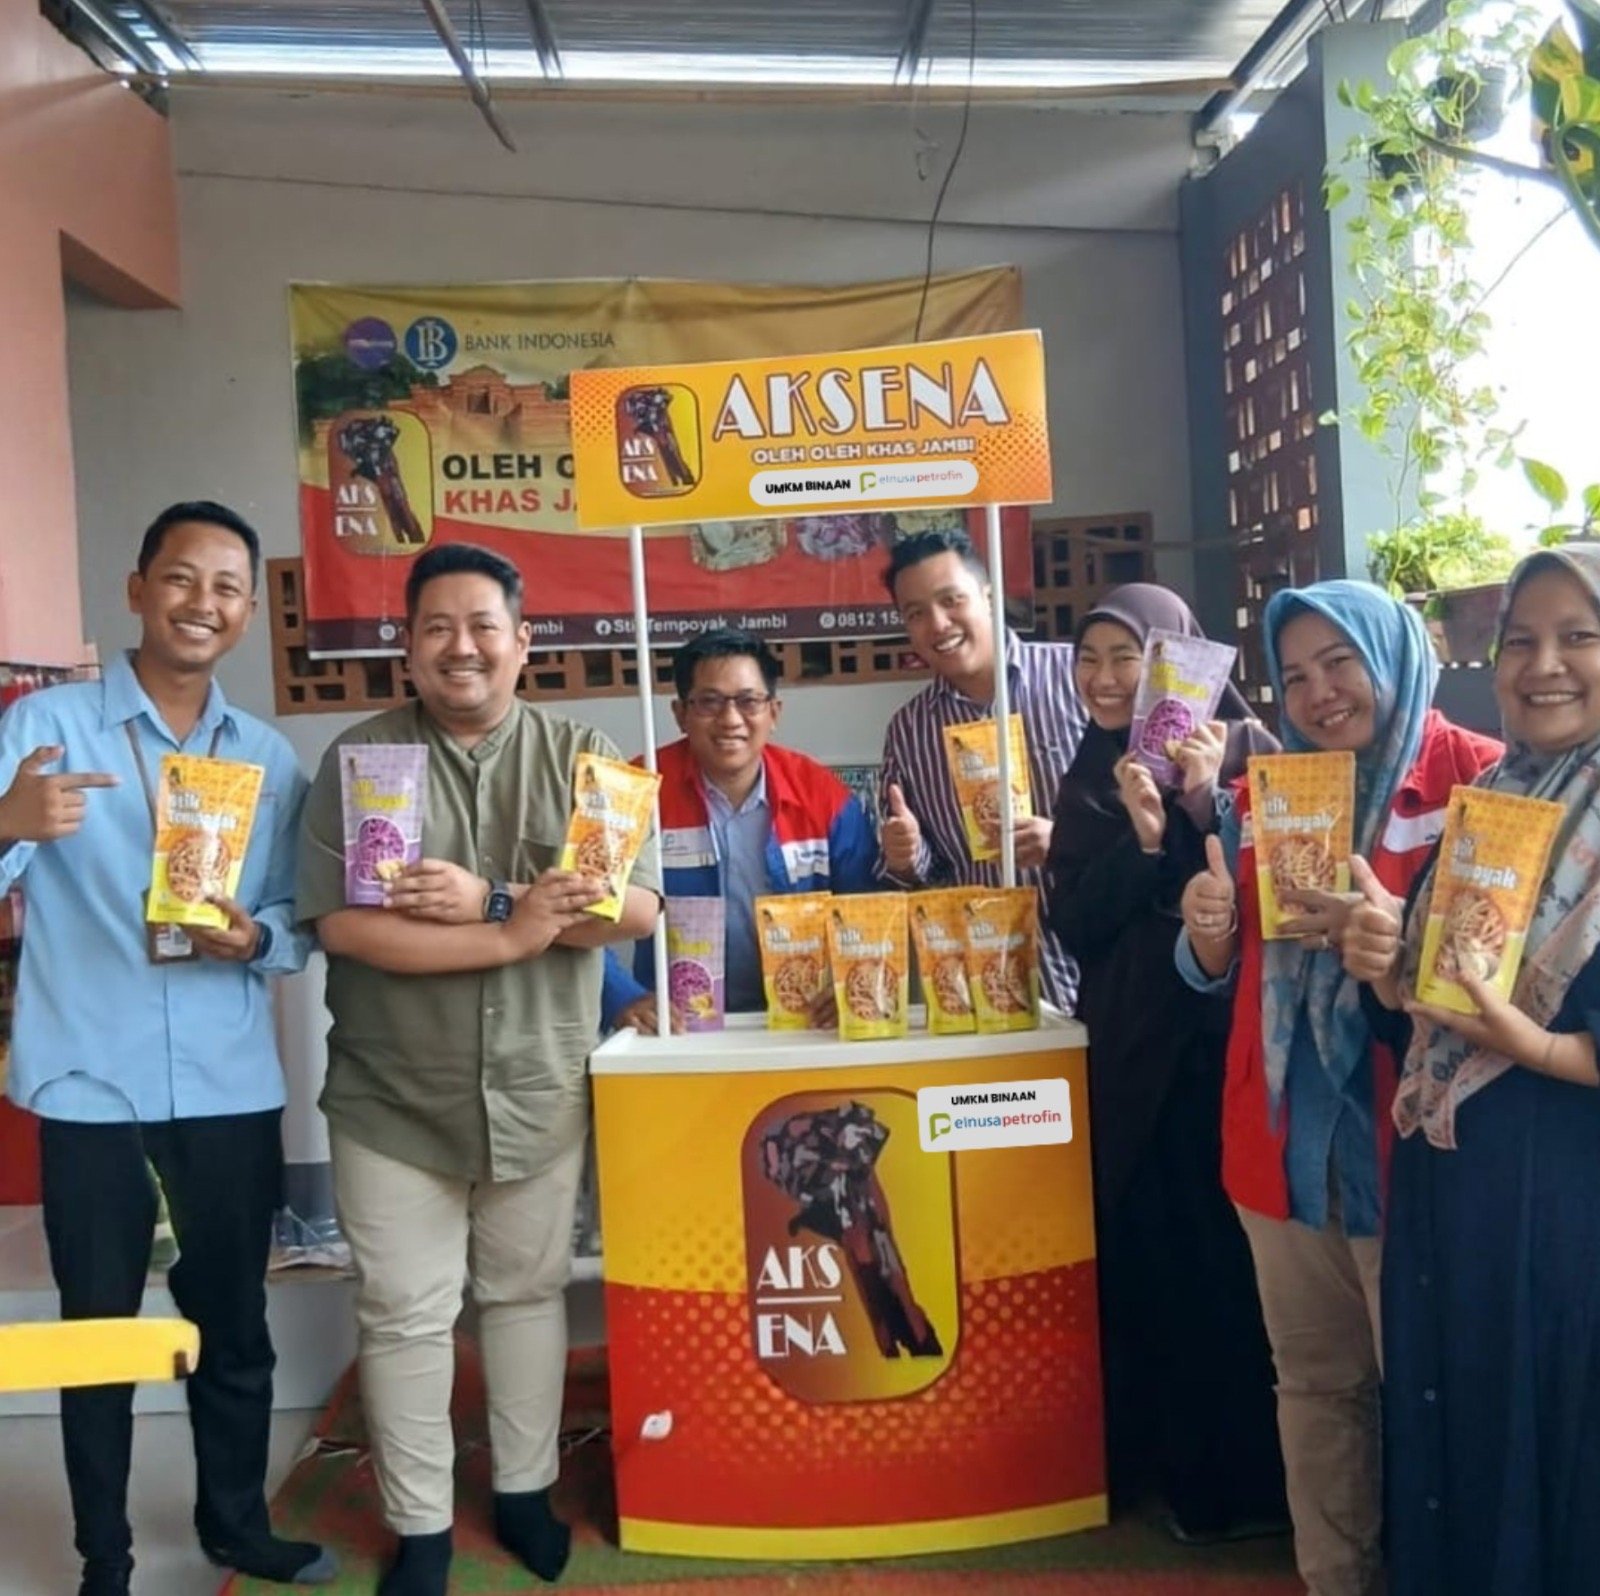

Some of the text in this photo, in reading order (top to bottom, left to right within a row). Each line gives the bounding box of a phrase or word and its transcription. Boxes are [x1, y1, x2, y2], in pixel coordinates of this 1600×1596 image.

[465, 332, 615, 351] BANK INDONESIA
[712, 357, 1011, 441] AKSENA
[753, 438, 976, 465] OLEH OLEH KHAS JAMBI
[442, 454, 541, 480] OLEH
[765, 481, 804, 494] UMKM
[805, 479, 852, 492] BINAAN
[444, 488, 577, 514] KHAS J
[613, 619, 637, 634] Sti
[837, 610, 904, 628] 0812 15
[951, 1090, 1036, 1106] UMKM BINAAN
[756, 1243, 842, 1290] AKS
[757, 1310, 848, 1358] ENA
